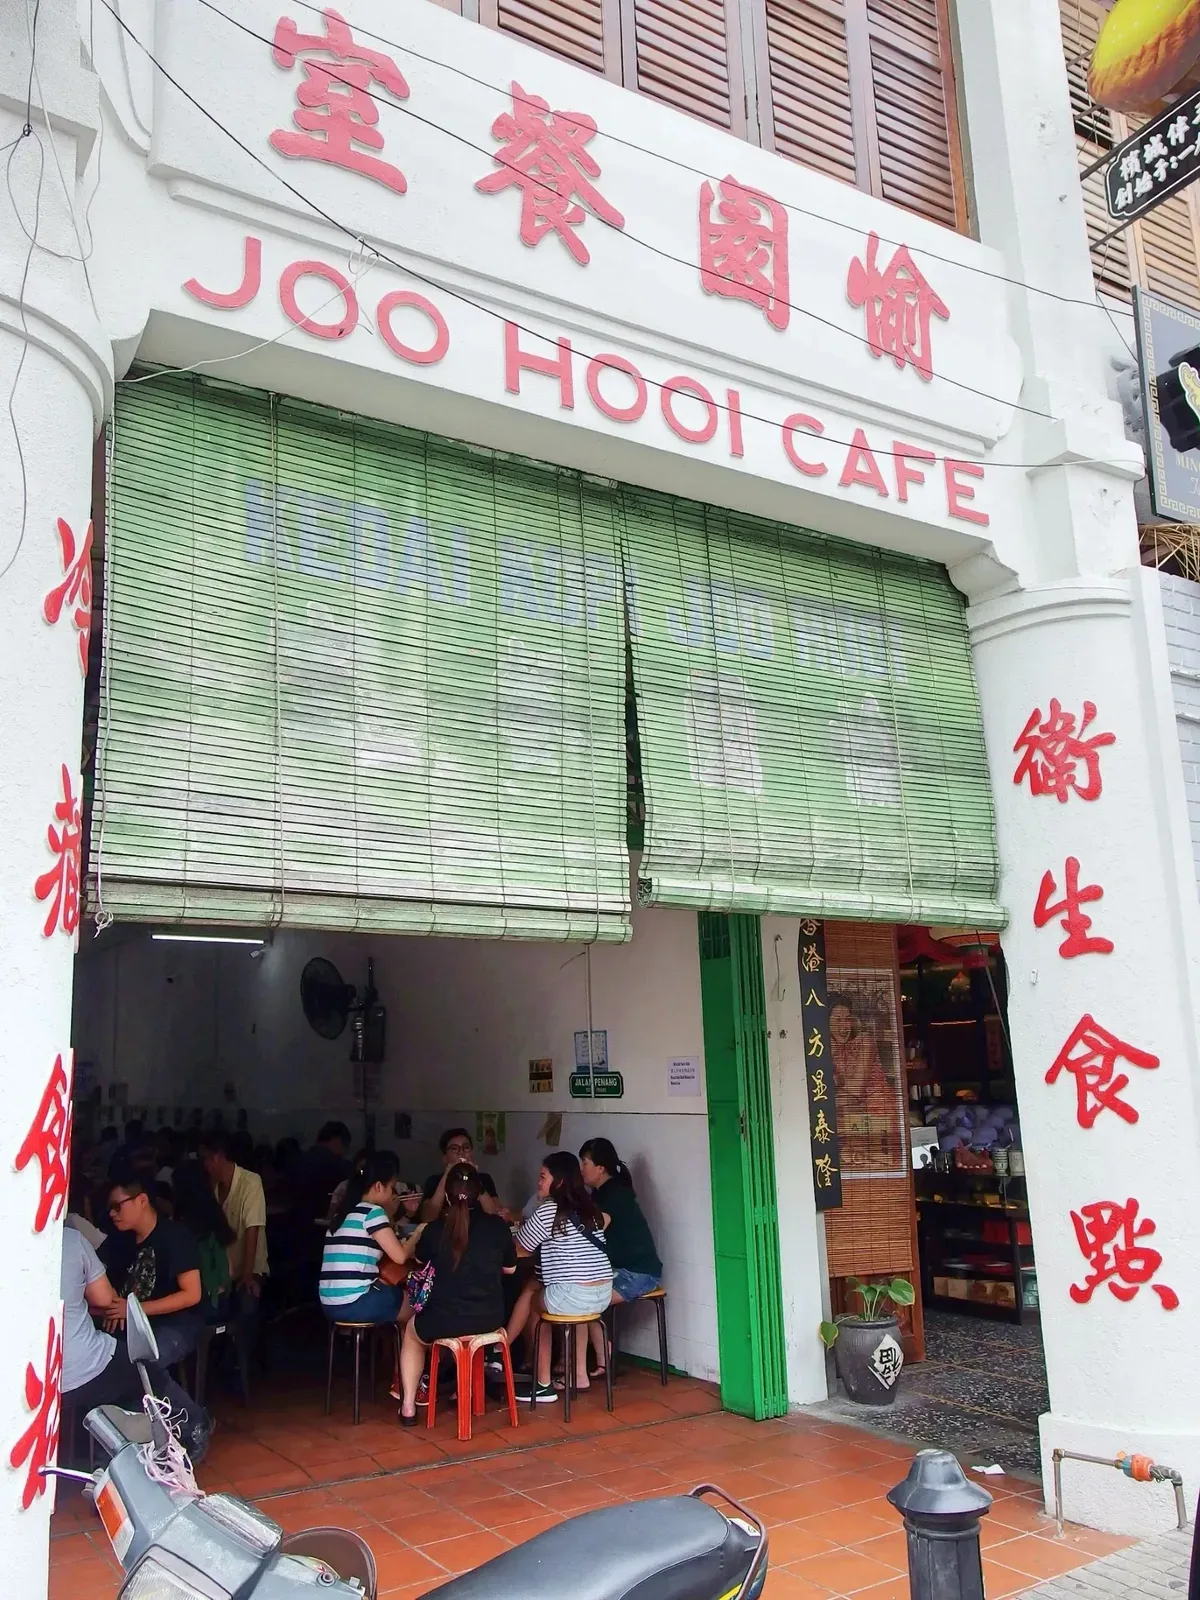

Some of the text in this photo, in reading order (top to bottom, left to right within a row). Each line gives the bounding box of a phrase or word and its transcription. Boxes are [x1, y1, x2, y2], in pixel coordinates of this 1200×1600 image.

[182, 236, 989, 526] JOO HOOI CAFE
[1176, 453, 1200, 472] MIN
[244, 478, 471, 606] KEDAI
[498, 538, 642, 636] KOPI
[594, 1077, 618, 1087] PENANG
